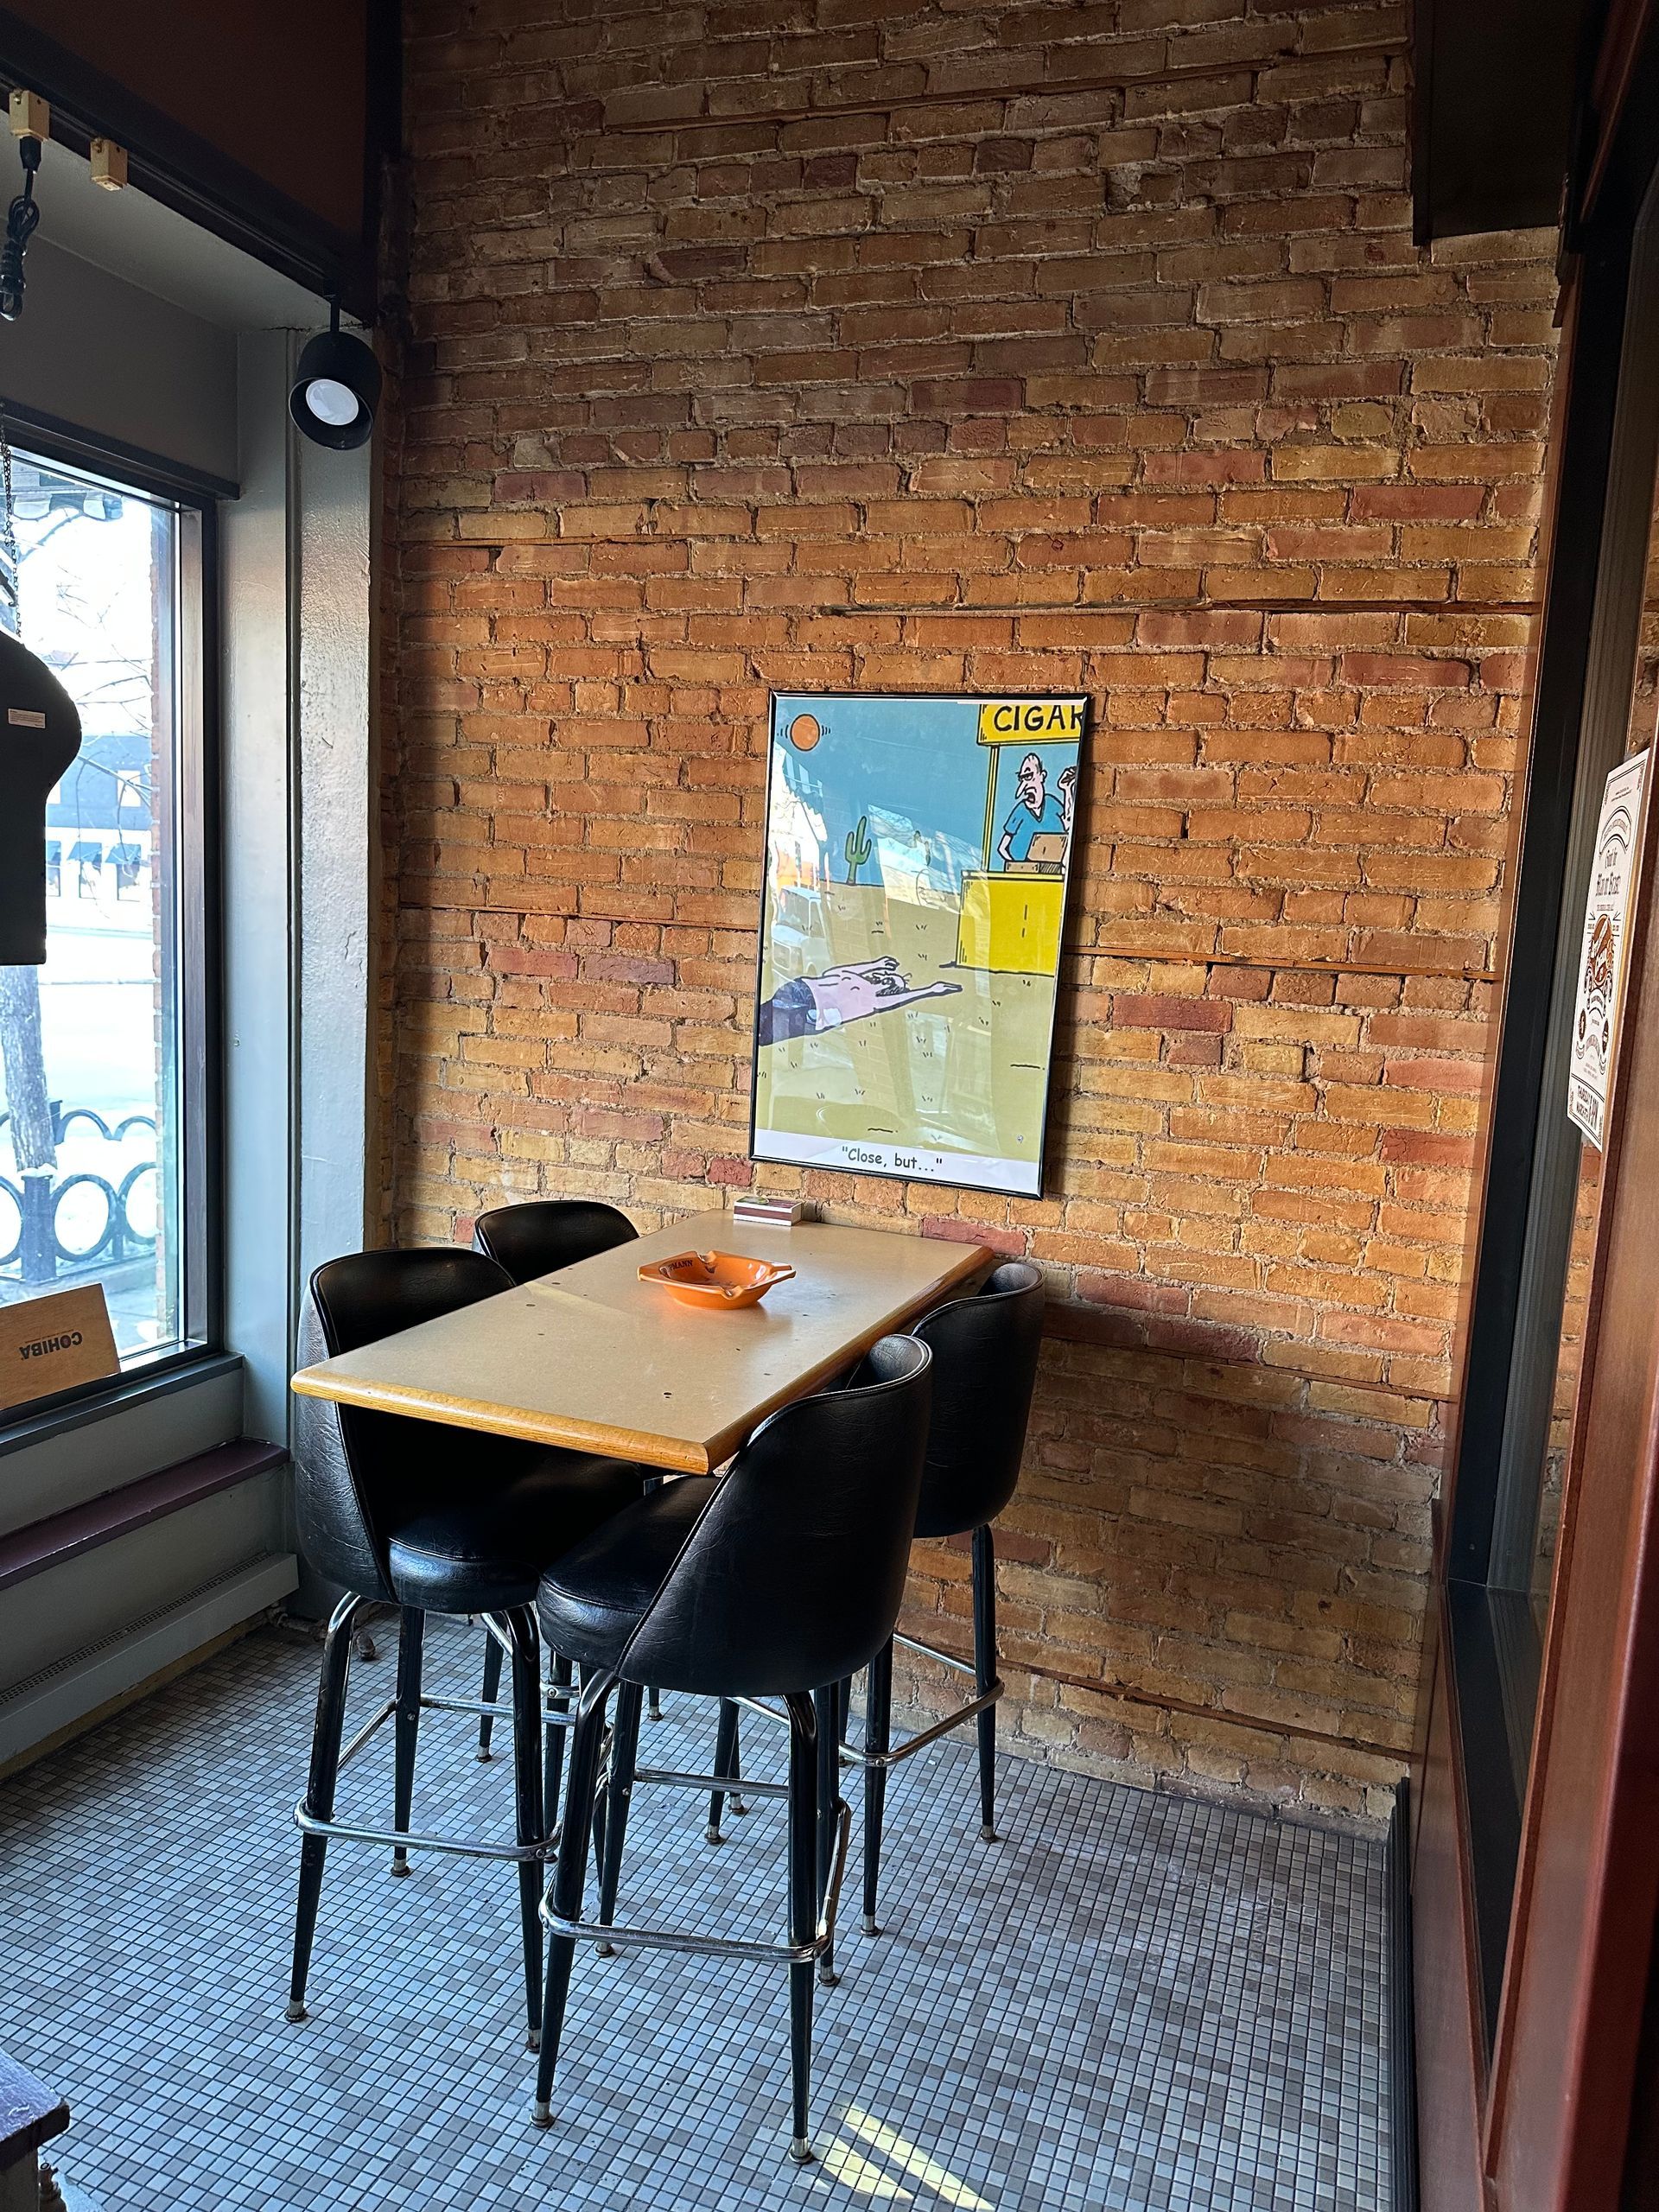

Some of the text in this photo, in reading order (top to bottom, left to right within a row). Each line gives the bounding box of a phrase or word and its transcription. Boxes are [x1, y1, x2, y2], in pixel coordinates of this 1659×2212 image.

[842, 1146, 943, 1172] "Close, but..."
[19, 1332, 83, 1359] COHIBA
